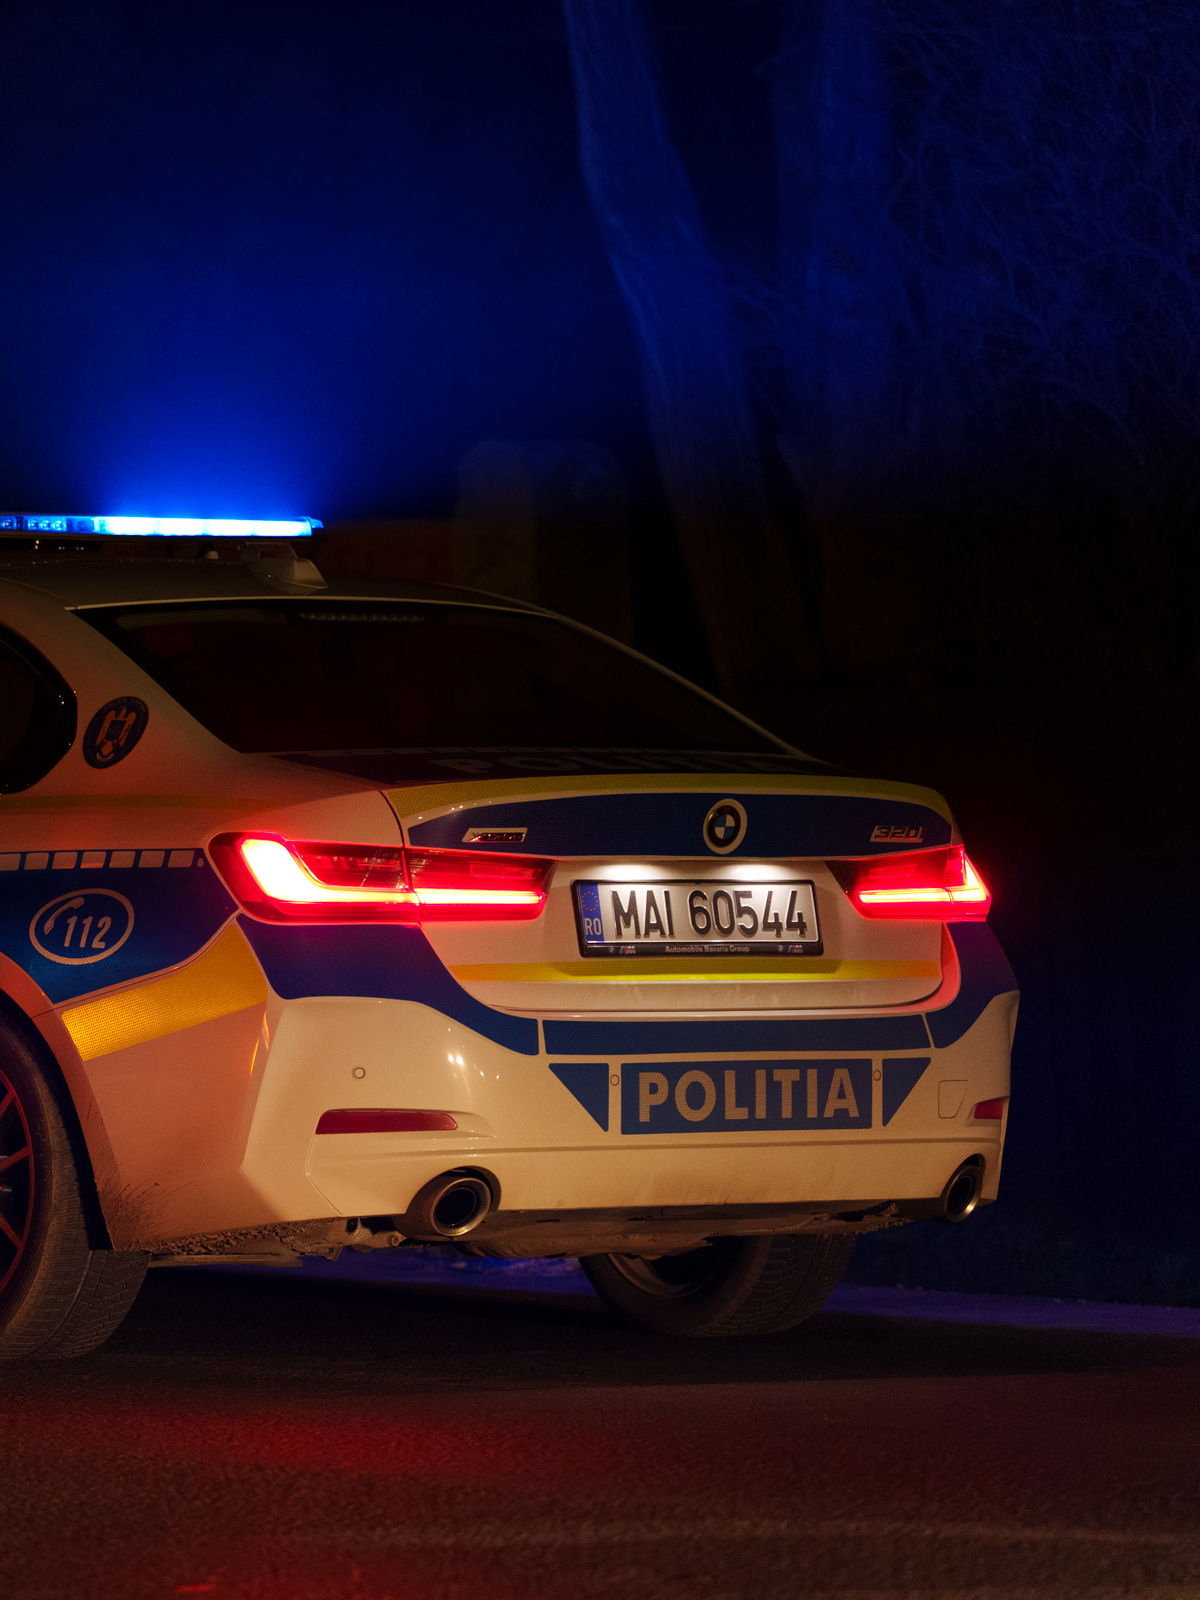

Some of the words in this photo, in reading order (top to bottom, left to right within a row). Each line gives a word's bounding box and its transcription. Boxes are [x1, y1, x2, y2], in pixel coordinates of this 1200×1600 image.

[583, 917, 602, 936] RO
[611, 890, 676, 937] MAI
[687, 890, 808, 937] 60544
[63, 915, 112, 949] 112
[665, 944, 703, 953] Automobile
[729, 944, 749, 954] Group
[638, 1067, 860, 1122] POLITIA
